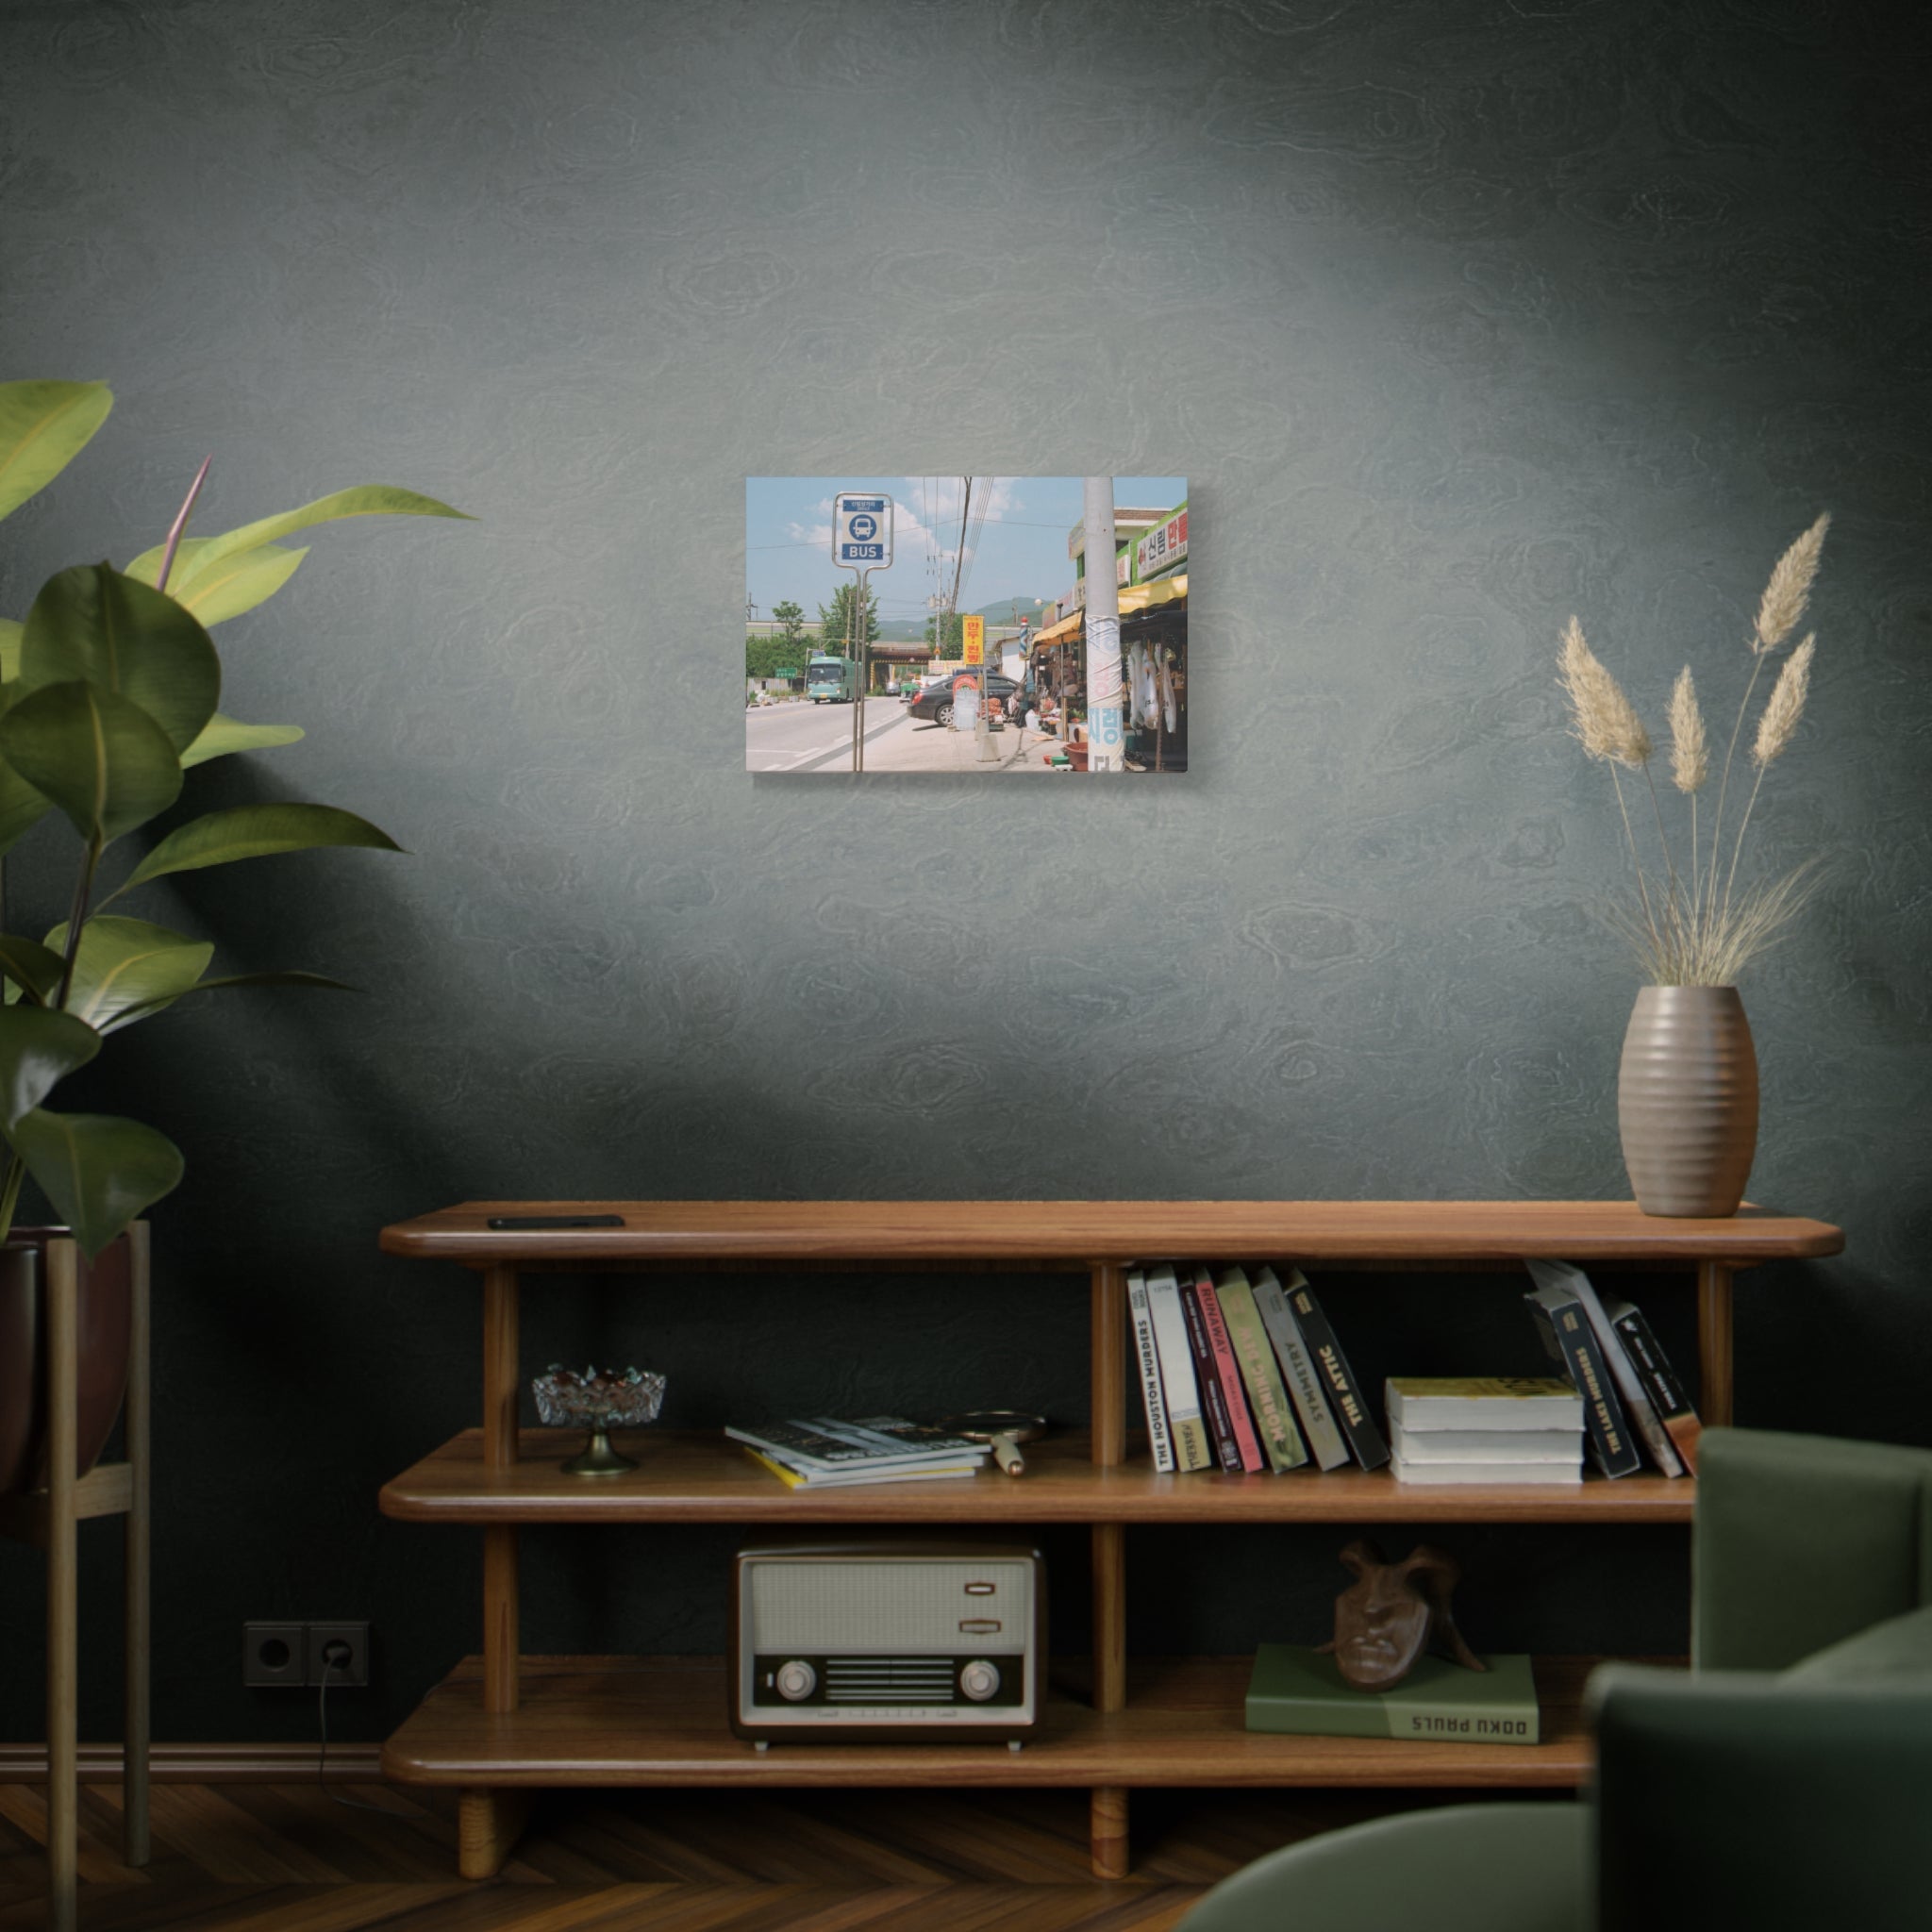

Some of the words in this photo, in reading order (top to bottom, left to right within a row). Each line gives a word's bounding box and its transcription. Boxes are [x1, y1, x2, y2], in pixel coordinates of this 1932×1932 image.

[849, 545, 876, 558] BUS
[1201, 1288, 1228, 1355] RUNAWAY
[1238, 1326, 1260, 1361] DEW
[1138, 1320, 1155, 1377] MURDERS
[1319, 1344, 1349, 1391] ATTIC
[1285, 1341, 1324, 1423] SYMMETRY
[1574, 1346, 1603, 1401] MURDERS
[1147, 1381, 1164, 1440] HOUSTON
[1250, 1364, 1287, 1441] MORNING
[1341, 1393, 1363, 1427] THE
[1594, 1401, 1613, 1431] LAKE
[1157, 1442, 1169, 1466] THE
[1606, 1431, 1622, 1456] THE
